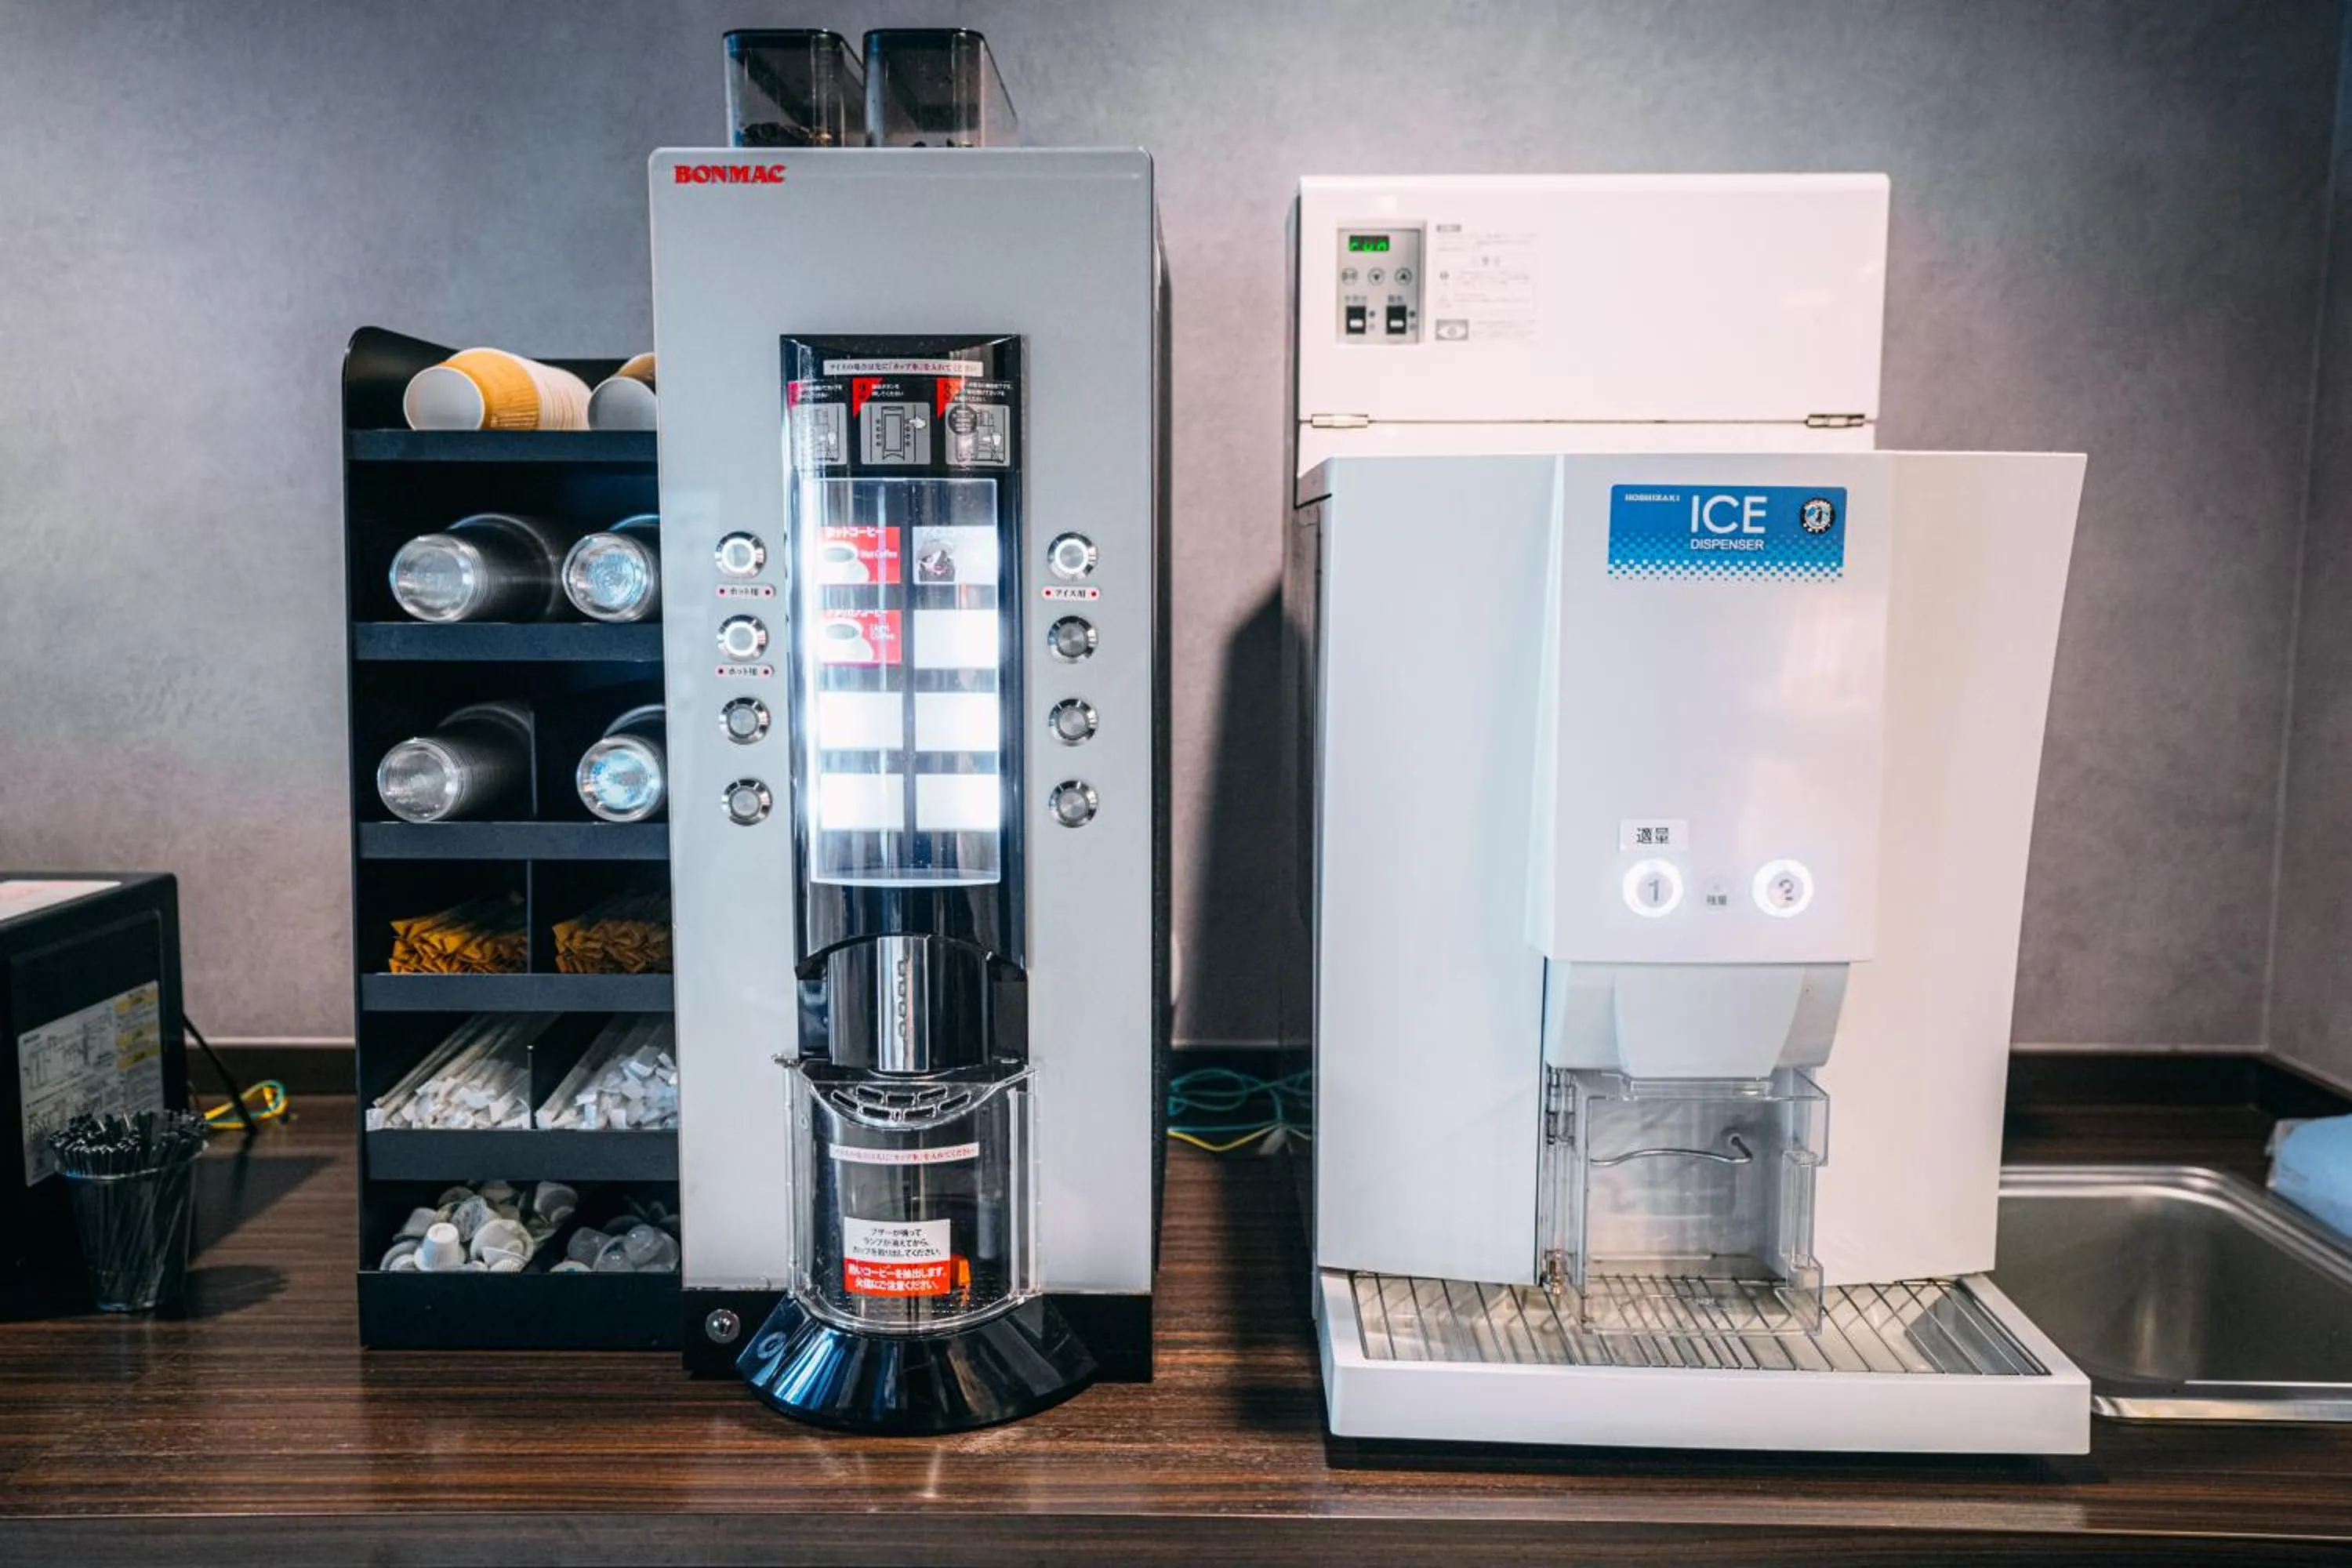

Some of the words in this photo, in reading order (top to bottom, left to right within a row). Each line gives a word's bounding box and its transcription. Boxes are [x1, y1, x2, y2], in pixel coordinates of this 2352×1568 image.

[674, 164, 788, 183] BONMAC
[1624, 493, 1680, 502] HOSHIZAKI
[1690, 495, 1768, 534] ICE
[1690, 539, 1764, 550] DISPENSER
[1648, 879, 1659, 902] 1
